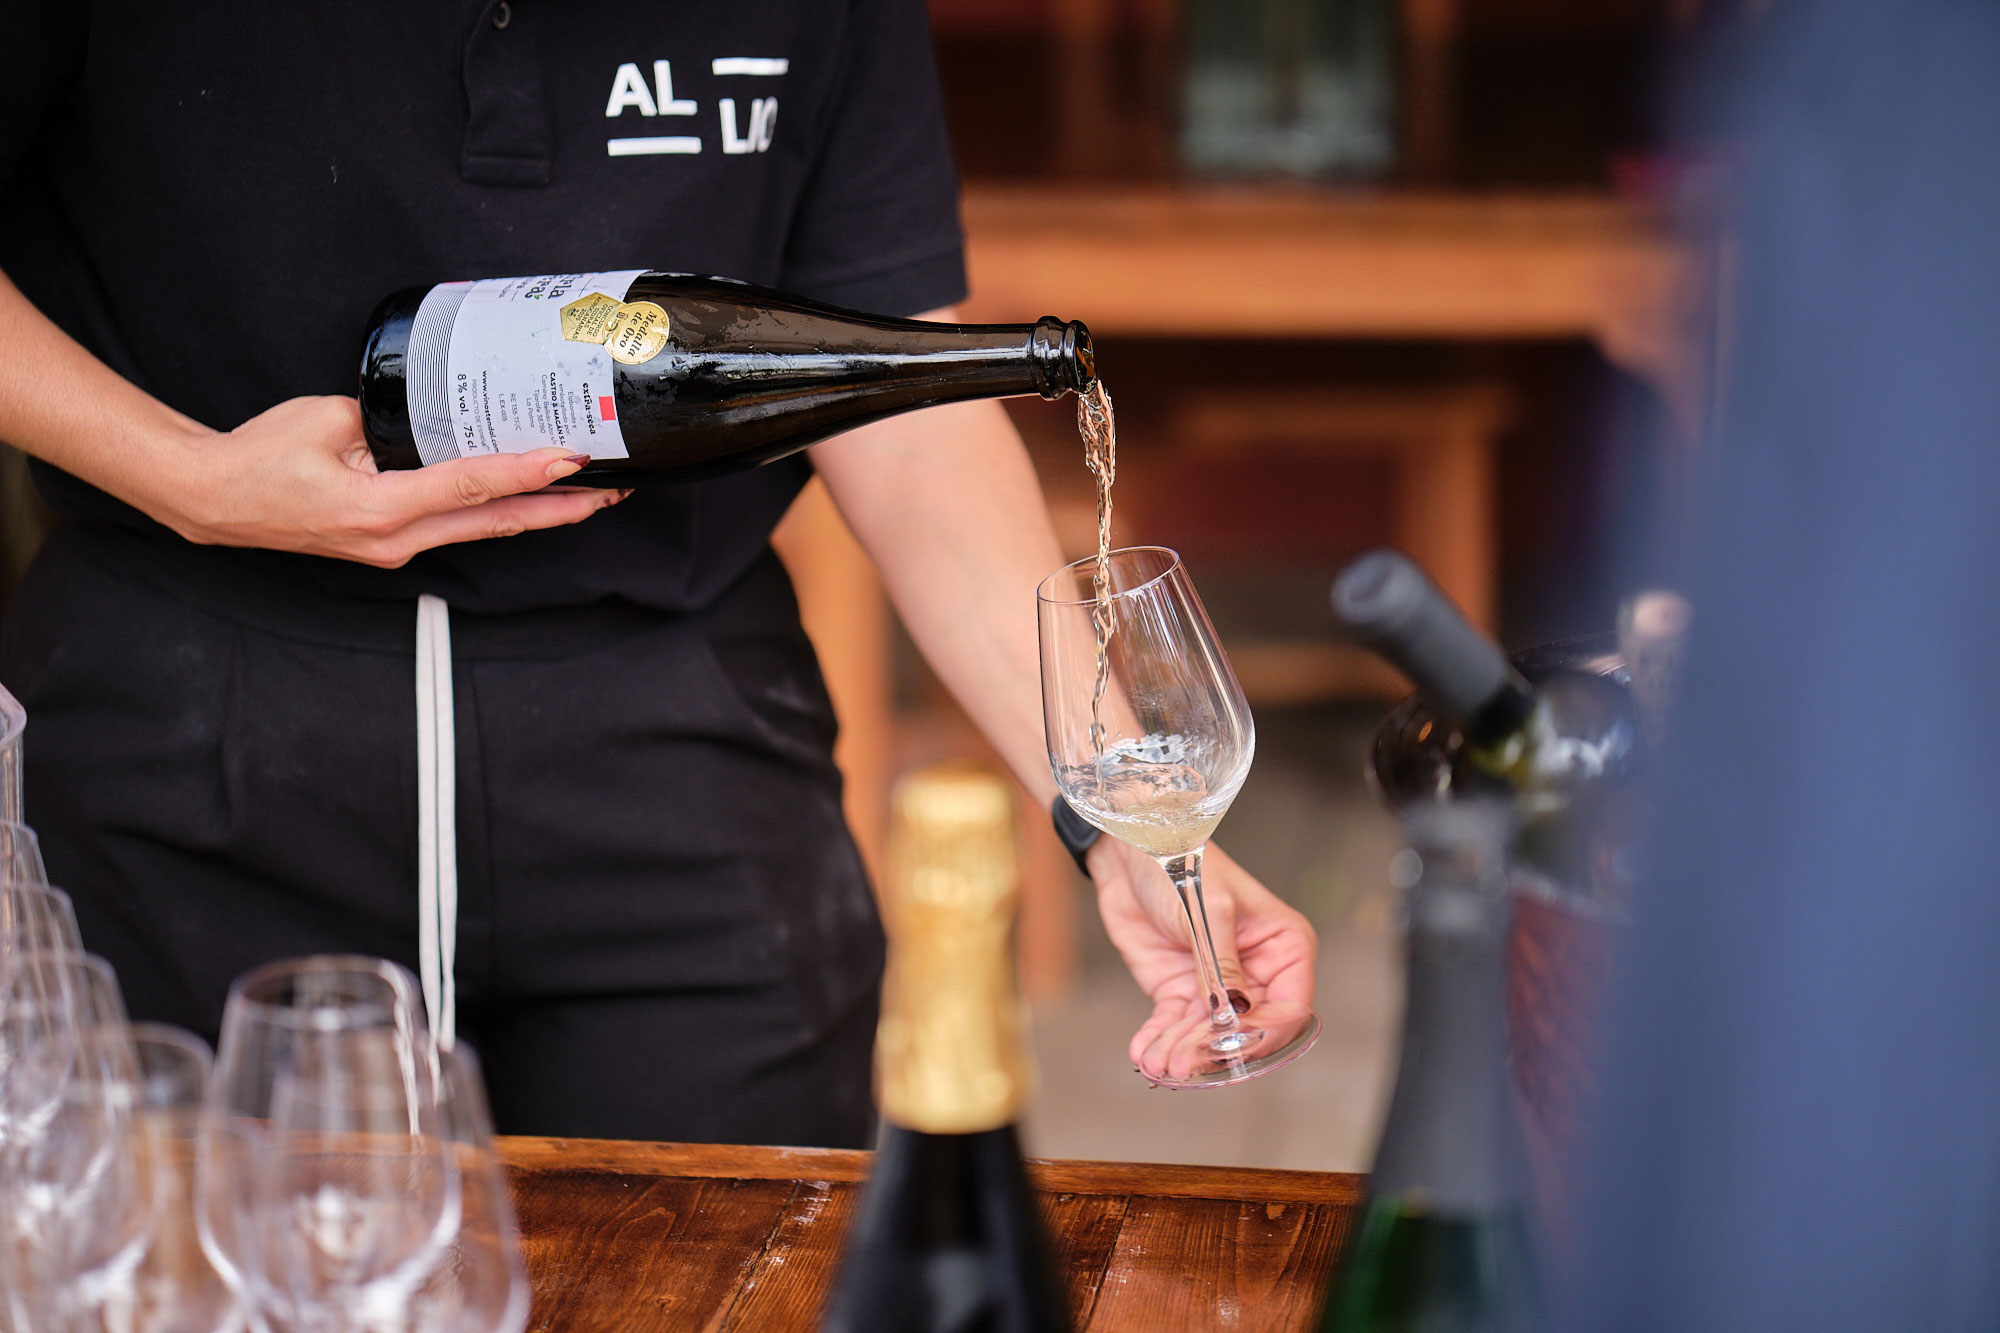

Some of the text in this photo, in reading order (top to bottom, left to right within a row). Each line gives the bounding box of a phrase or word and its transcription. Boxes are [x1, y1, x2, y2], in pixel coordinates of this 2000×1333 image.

[606, 59, 698, 117] AL
[572, 296, 602, 339] AGROCANARIAS
[584, 307, 599, 328] SIDRAS
[586, 304, 608, 335] OFICIAL DE
[592, 305, 613, 337] CONCURSO
[619, 311, 642, 348] de Oro
[628, 310, 658, 357] Medalla
[459, 395, 469, 416] vol.
[472, 379, 480, 415] PRODUCTO
[482, 370, 499, 453] www.vinostendal.com
[526, 397, 532, 407] La
[533, 388, 541, 413] Tijarafe
[559, 383, 568, 424] embotellado
[568, 391, 577, 424] Elaborado
[583, 382, 596, 435] extra-seca
[464, 425, 475, 438] 75
[475, 415, 482, 424] DE
[468, 440, 478, 451] cl.
